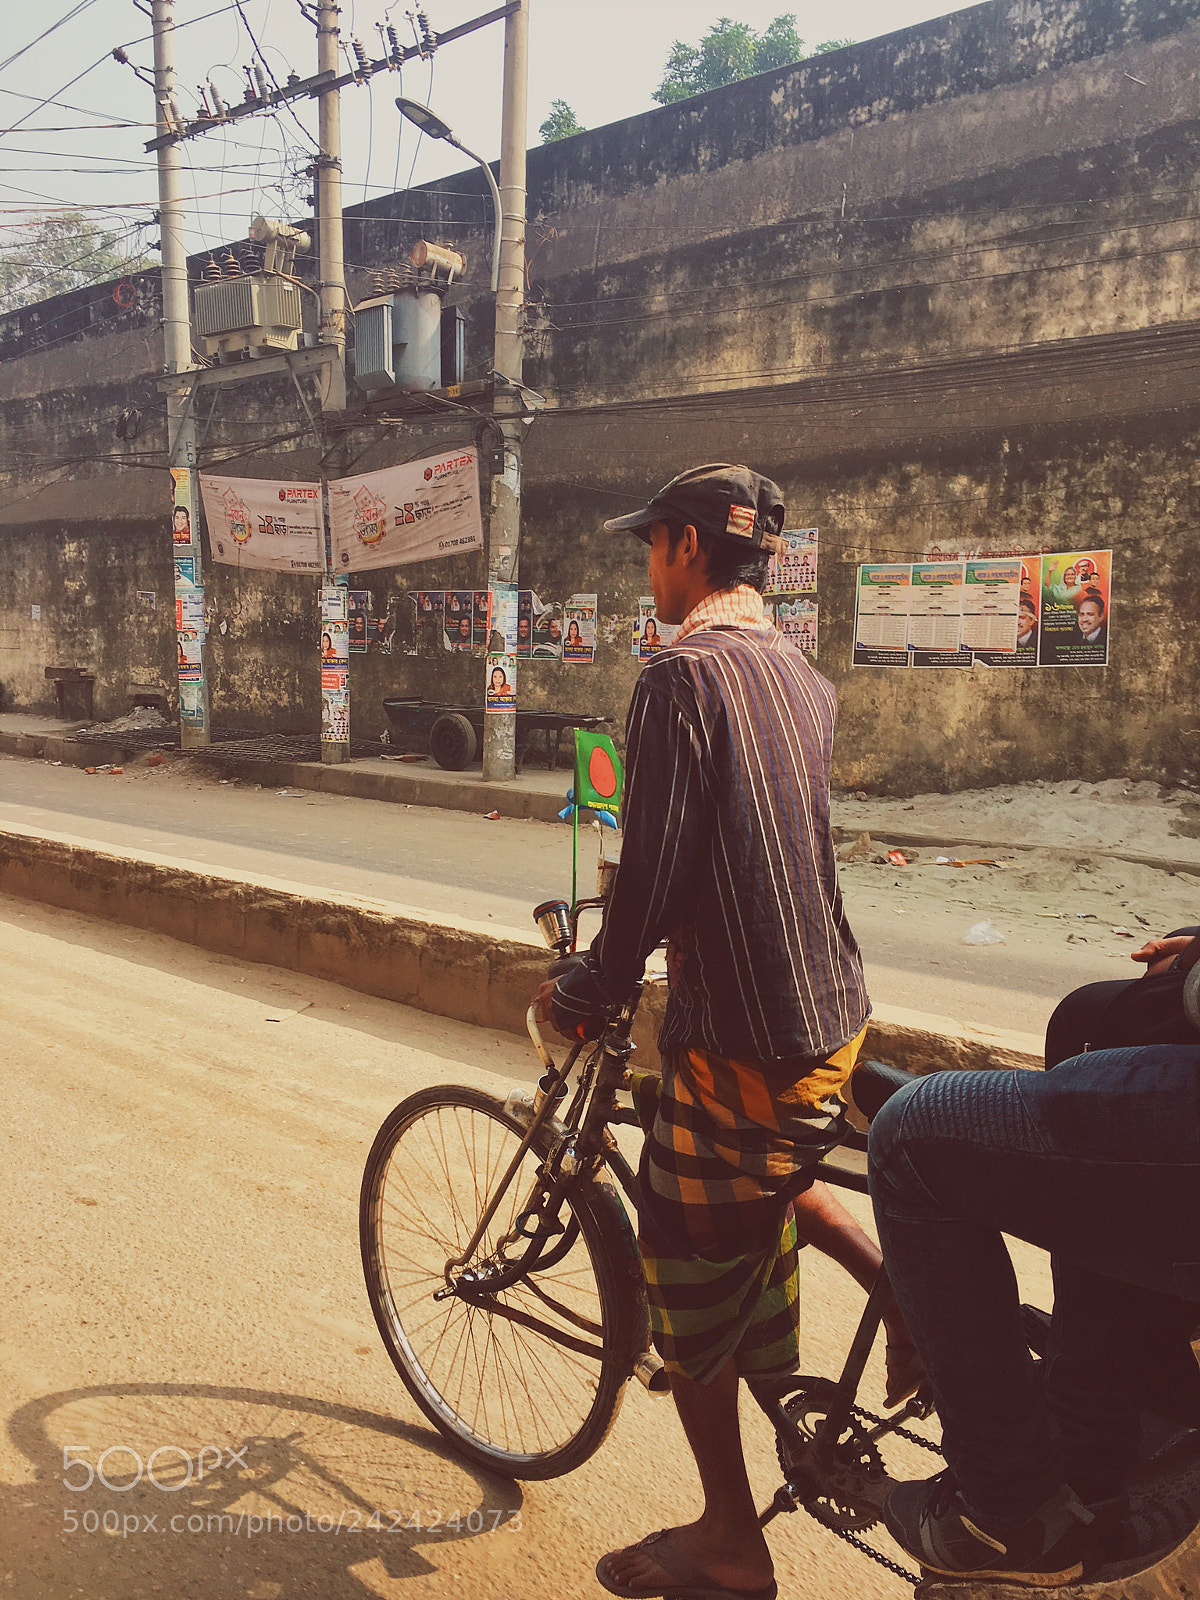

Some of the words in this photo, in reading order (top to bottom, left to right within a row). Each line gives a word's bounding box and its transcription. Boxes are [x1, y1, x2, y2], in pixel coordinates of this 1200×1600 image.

[434, 454, 474, 475] PARTEX
[286, 488, 319, 499] PARTEX
[1044, 602, 1060, 612] ১৬
